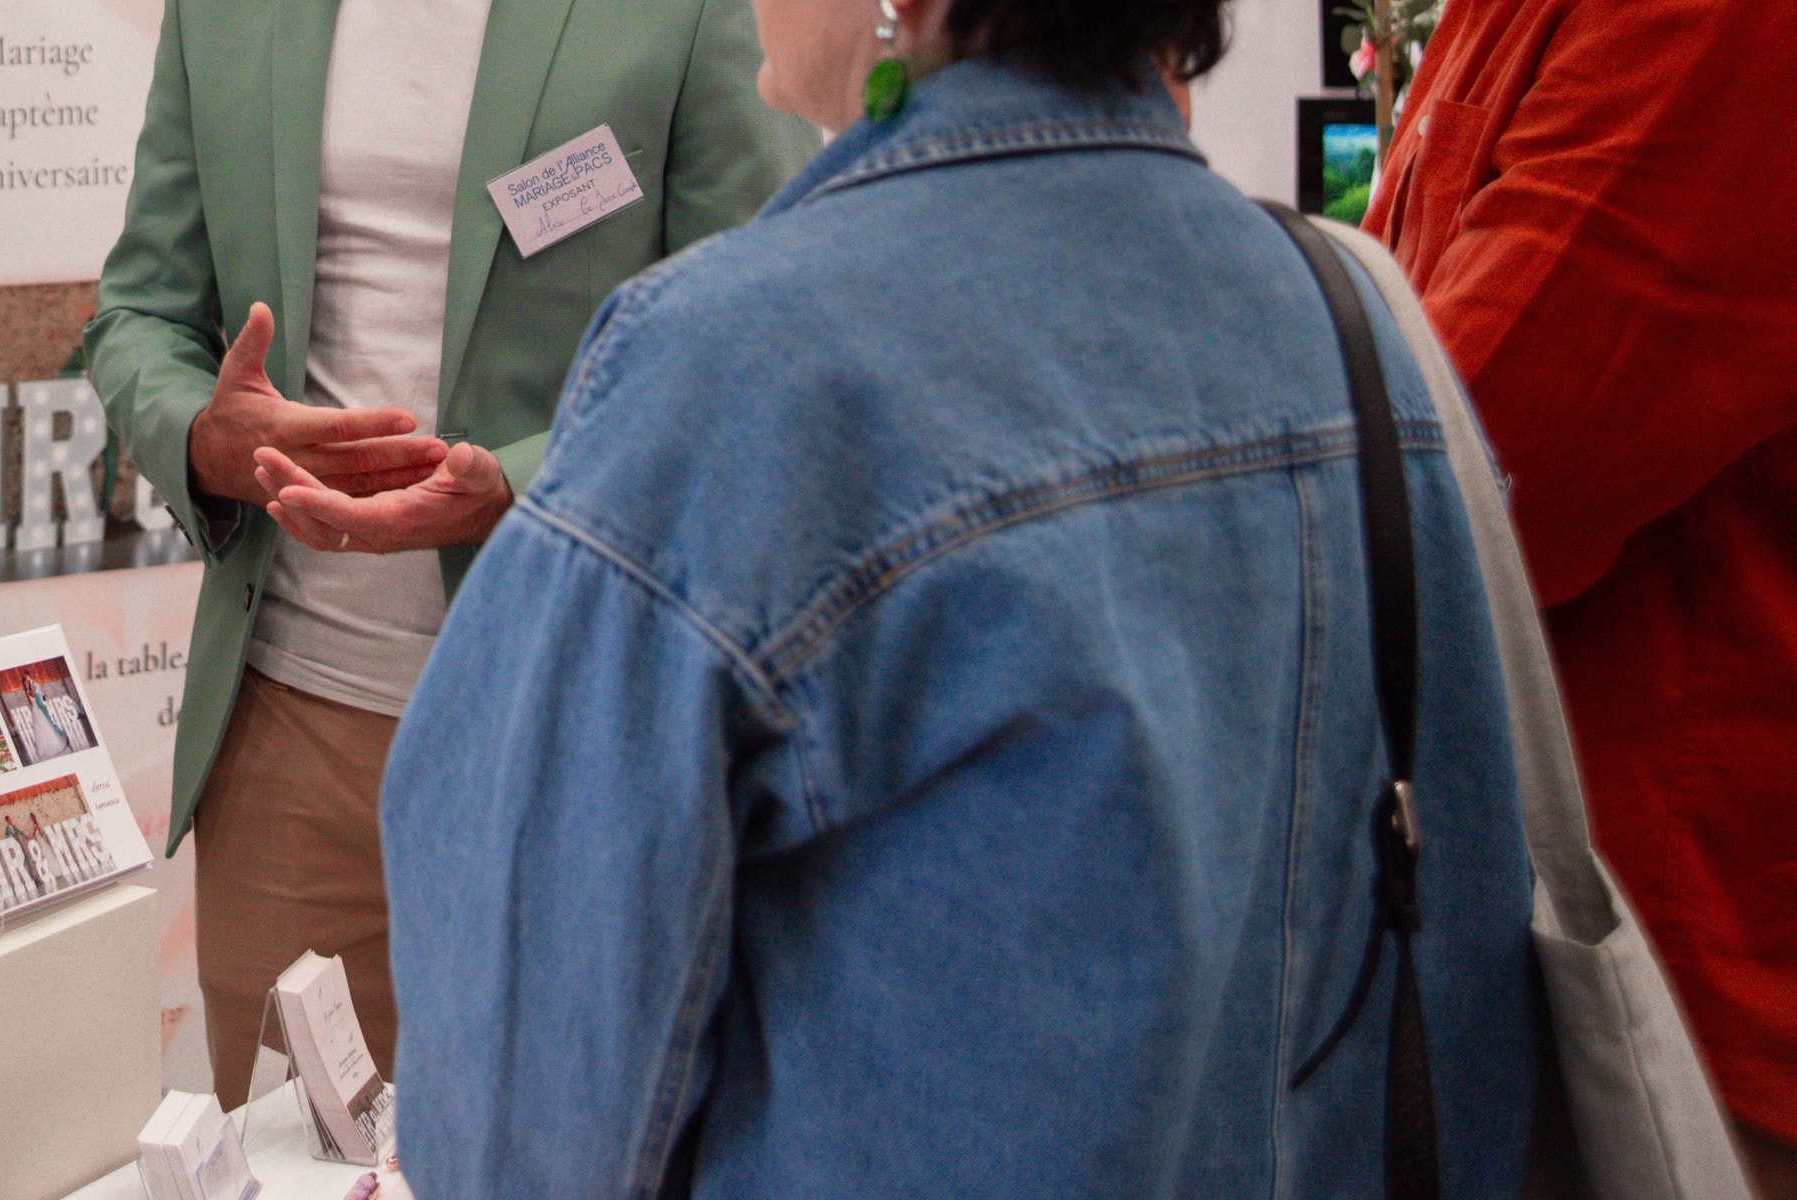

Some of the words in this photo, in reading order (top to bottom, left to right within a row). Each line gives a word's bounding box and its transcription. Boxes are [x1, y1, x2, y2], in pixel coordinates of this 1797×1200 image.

[507, 173, 541, 197] Salon
[541, 166, 557, 181] de
[556, 141, 607, 175] l'Alliance
[542, 178, 597, 213] EXPOSANT
[86, 651, 108, 681] la
